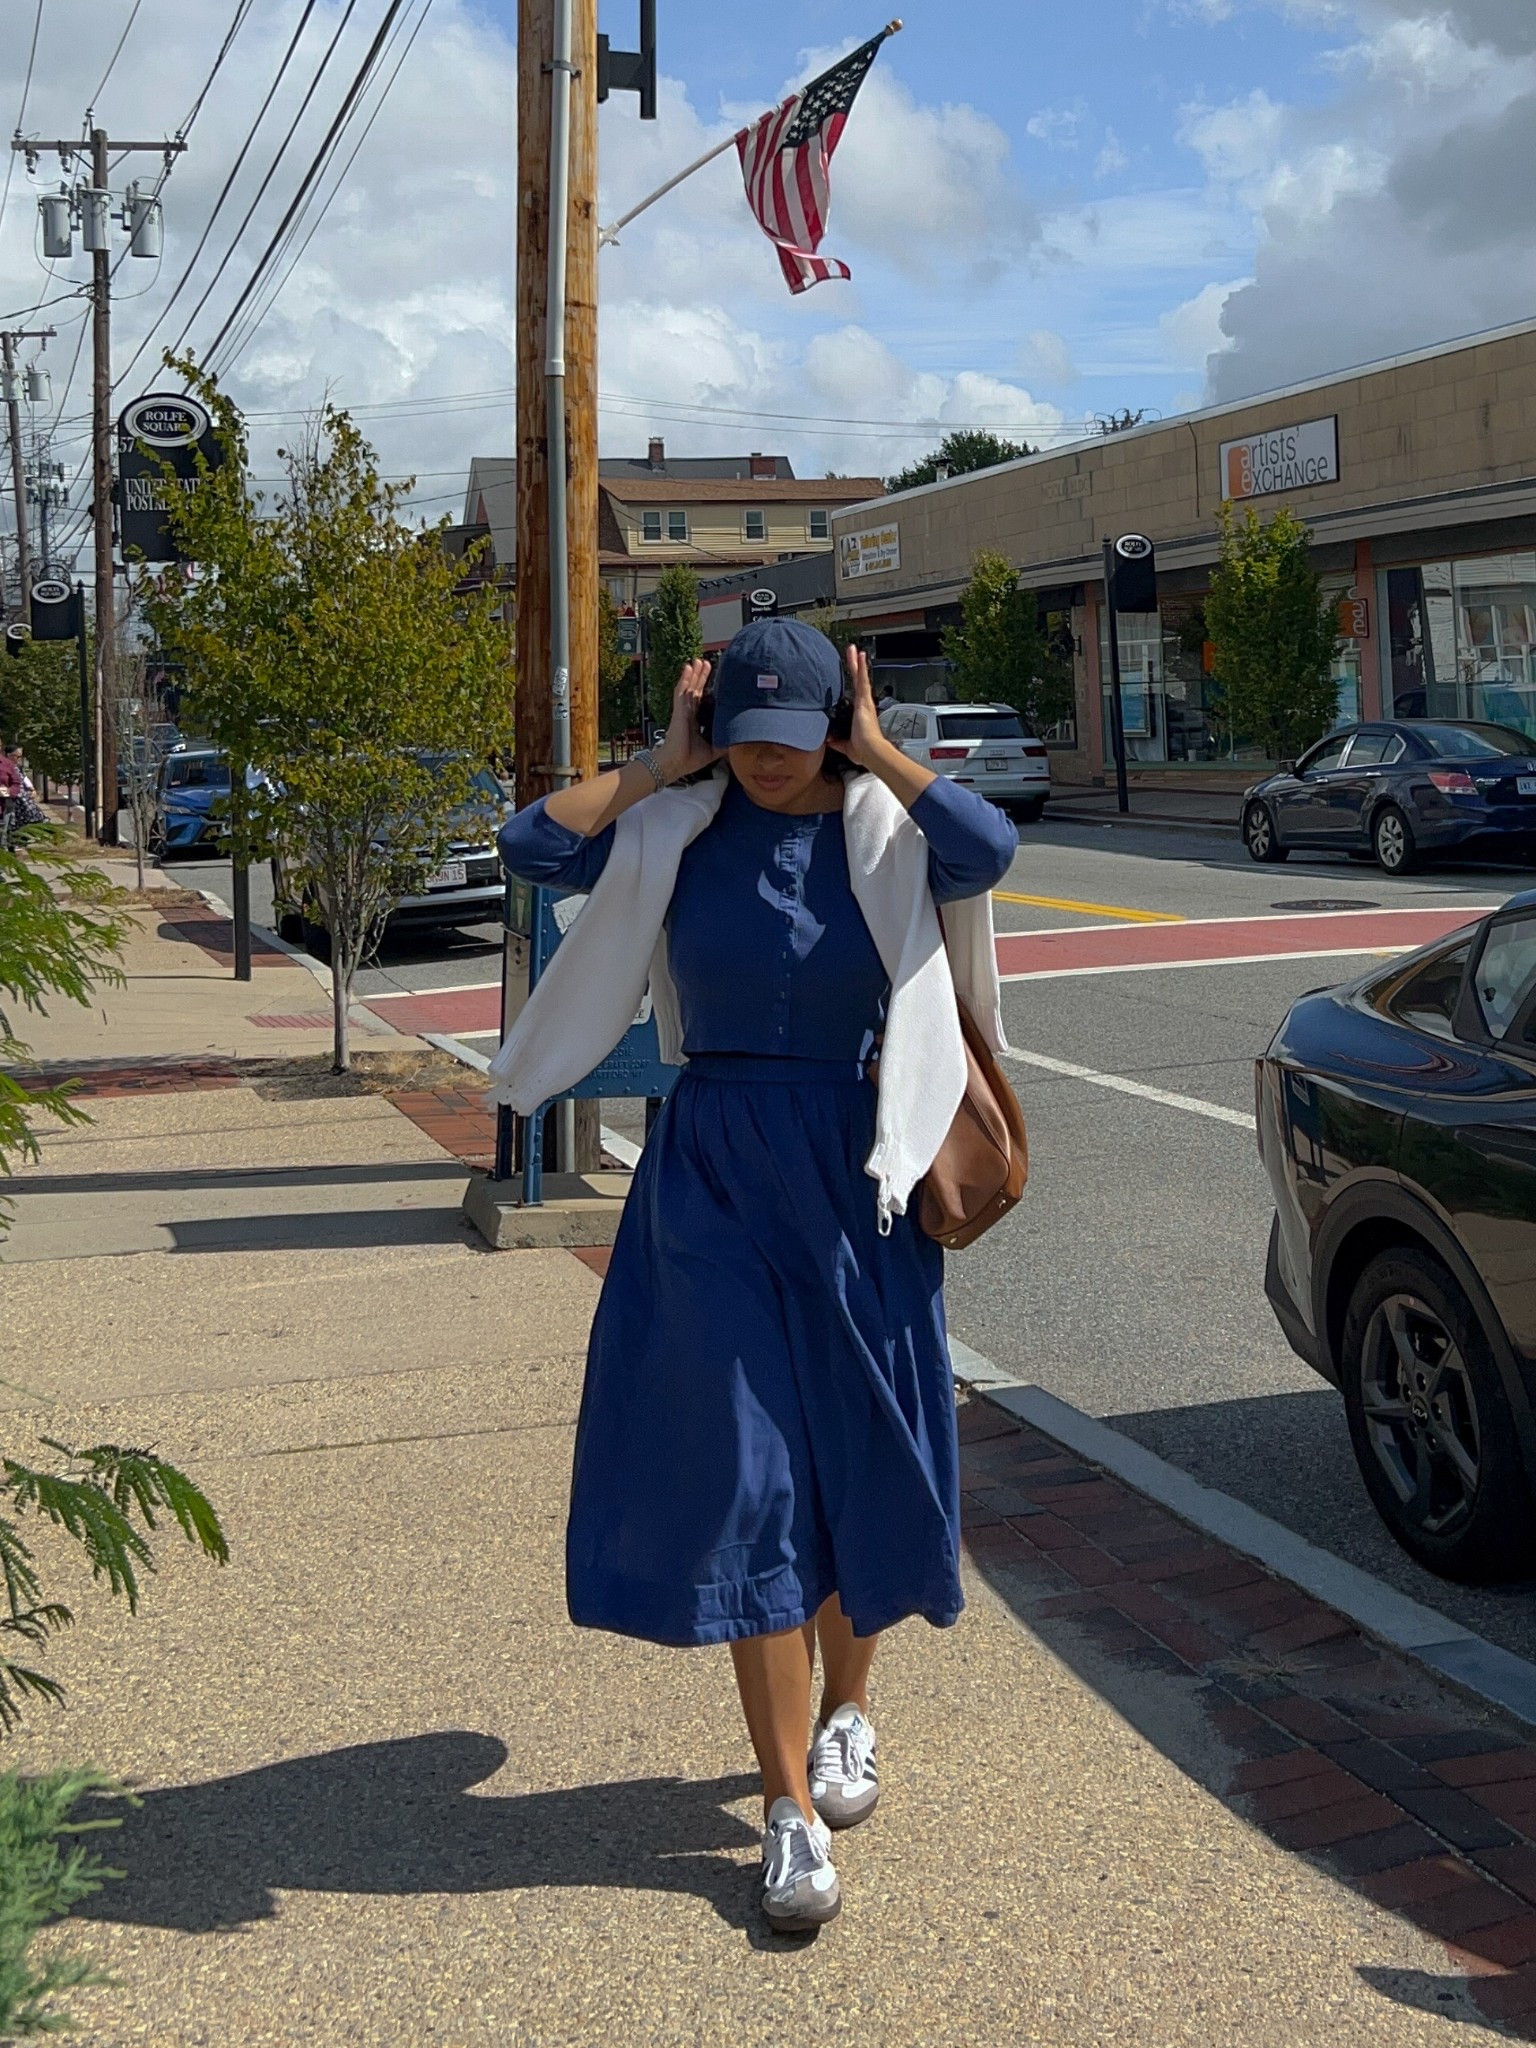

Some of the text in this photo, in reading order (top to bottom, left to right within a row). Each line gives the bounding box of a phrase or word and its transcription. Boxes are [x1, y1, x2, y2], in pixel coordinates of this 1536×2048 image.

[145, 411, 187, 421] ROLFE
[143, 422, 183, 432] SQUAR
[119, 436, 134, 453] 57
